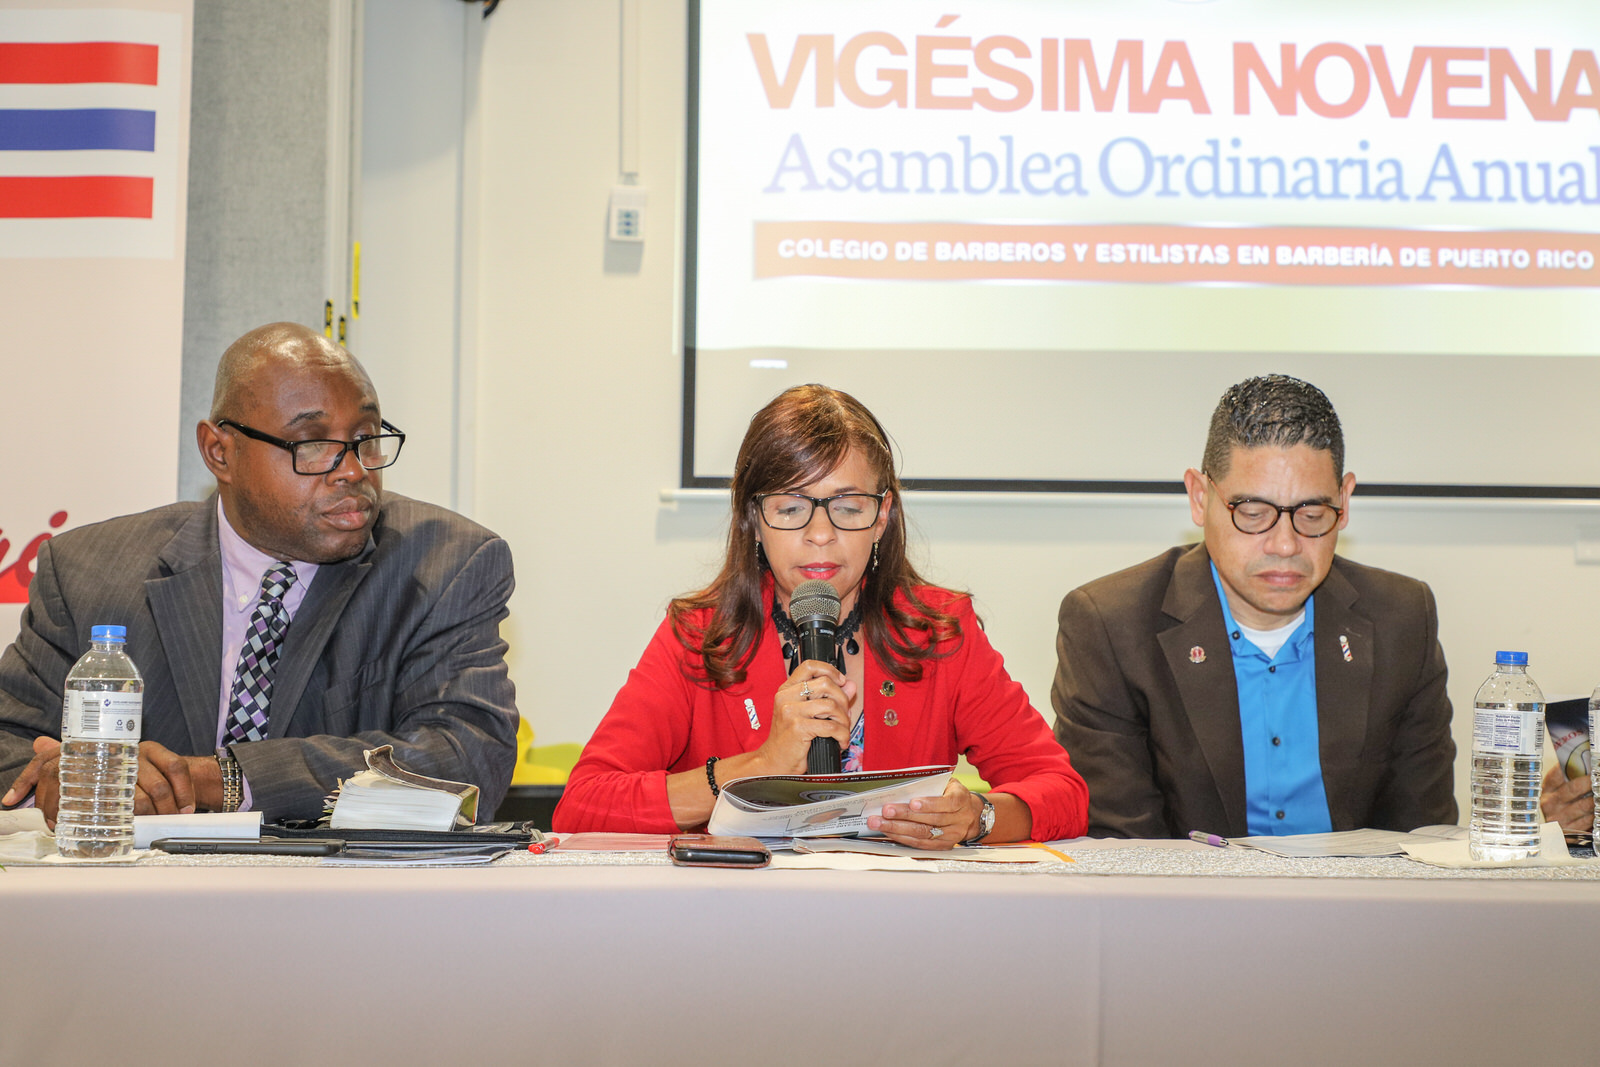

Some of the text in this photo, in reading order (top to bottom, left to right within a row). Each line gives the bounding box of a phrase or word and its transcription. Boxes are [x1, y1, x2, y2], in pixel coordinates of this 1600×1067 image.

[745, 14, 1600, 122] VIGÉSIMA NOVENA
[762, 133, 1600, 206] Asamblea Ordinaria Anual
[778, 239, 1595, 270] COLEGIO DE BARBEROS Y ESTILISTAS EN BARBERÍA DE PUERTO RICO
